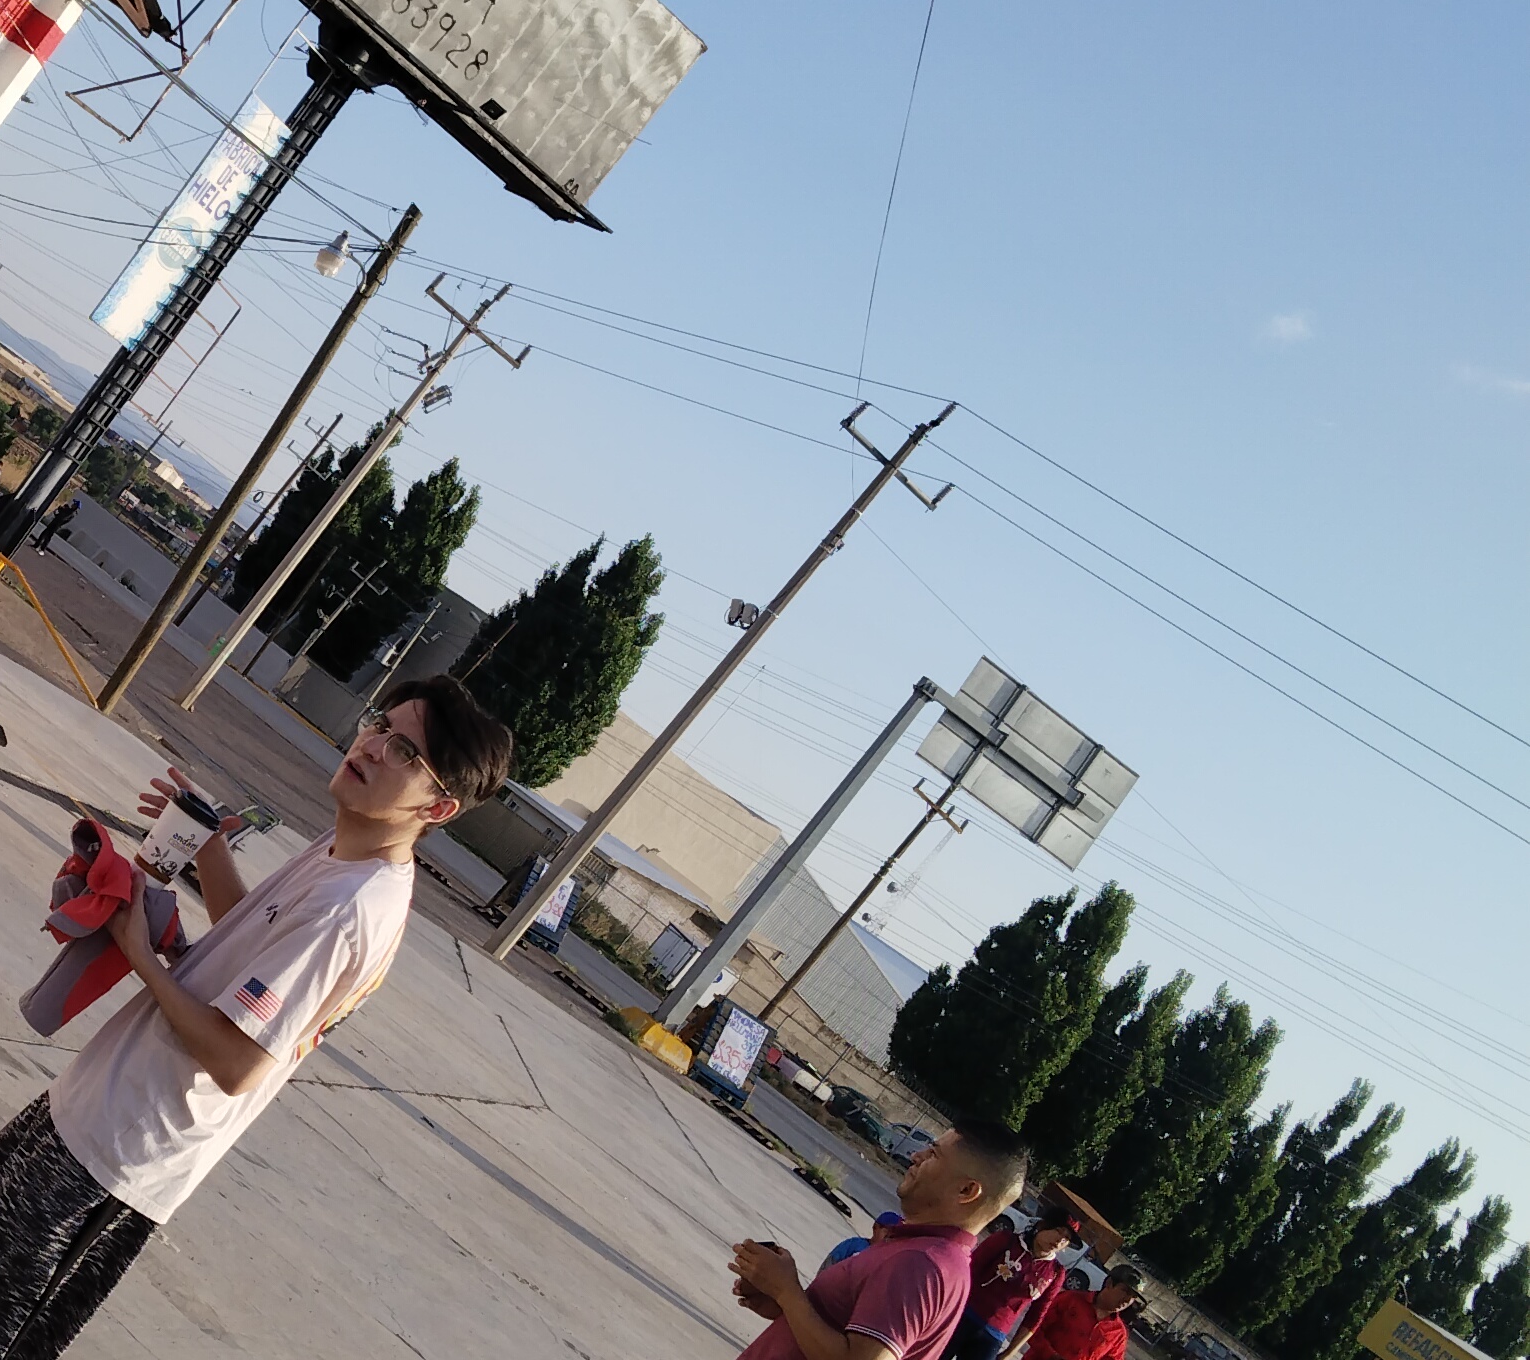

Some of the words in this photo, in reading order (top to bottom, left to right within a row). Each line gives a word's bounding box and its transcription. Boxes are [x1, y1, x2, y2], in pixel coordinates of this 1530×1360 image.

[218, 129, 266, 178] FABRICA
[188, 173, 233, 222] HIELO
[216, 164, 239, 193] DE
